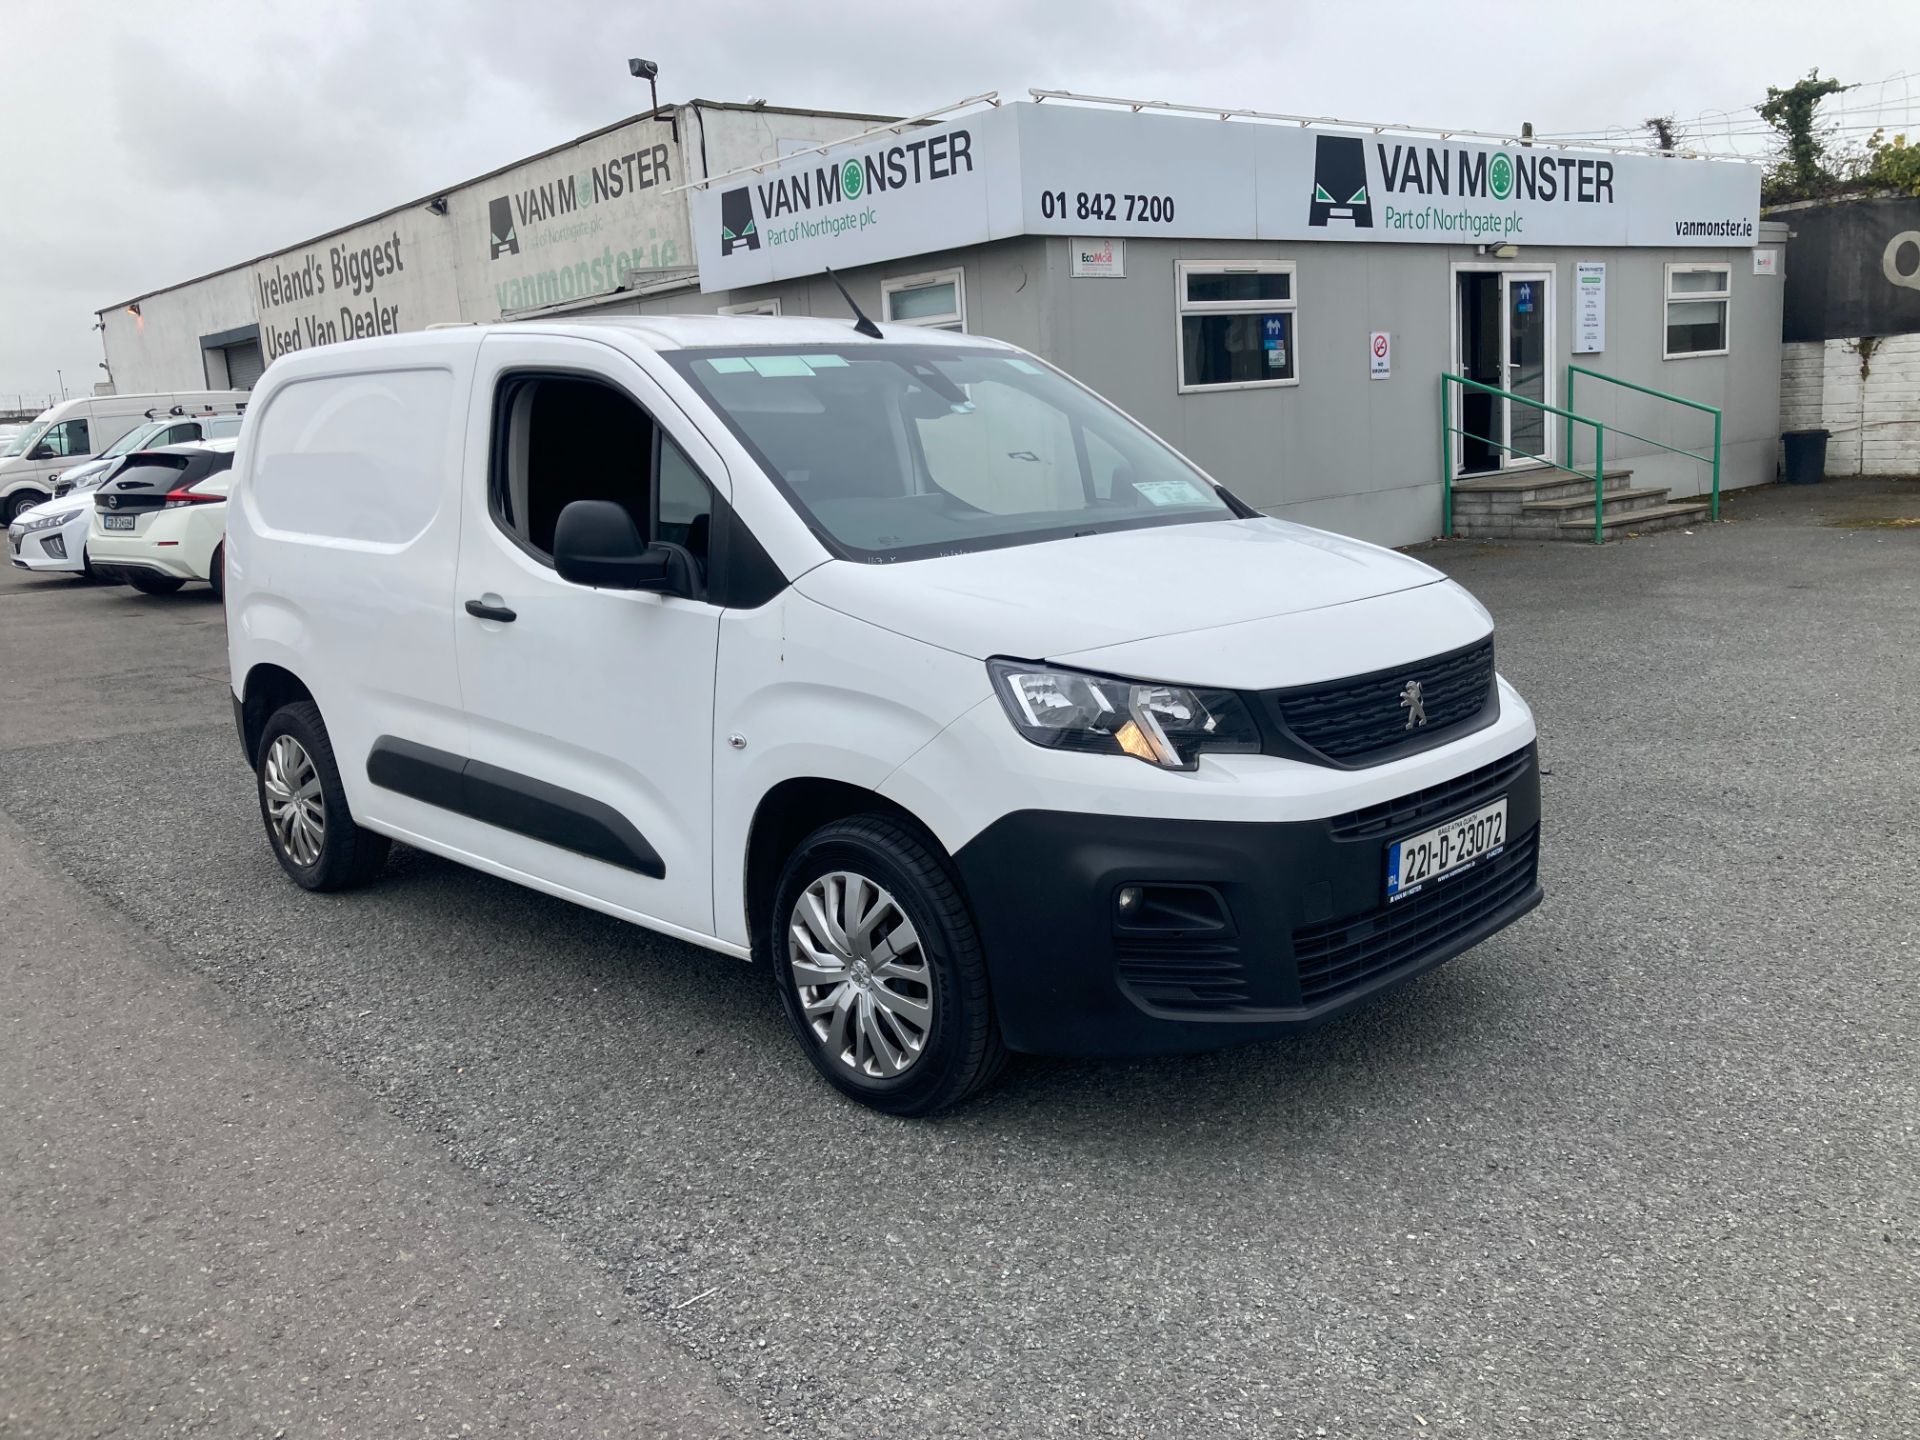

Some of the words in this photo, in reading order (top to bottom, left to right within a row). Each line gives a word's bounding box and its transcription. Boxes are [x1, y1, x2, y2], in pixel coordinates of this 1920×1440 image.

[515, 182, 556, 227] VAN
[557, 143, 671, 215] MONSTER
[757, 172, 810, 219] VAN
[815, 129, 974, 207] MONSTER
[1377, 143, 1449, 196] VAN
[1458, 150, 1614, 203] MONSTER
[767, 229, 788, 247] Part
[788, 222, 800, 242] of
[800, 212, 857, 239] Northgate
[859, 206, 877, 232] plc
[1041, 190, 1067, 219] 01
[1076, 192, 1117, 220] 842
[1124, 194, 1175, 223] 7200
[1385, 206, 1414, 230] Part
[1415, 206, 1432, 230] of
[1433, 208, 1502, 237] Northgate
[1504, 211, 1523, 237] plc
[1675, 217, 1752, 238] vanmonster.ie
[258, 254, 325, 309] Ireland's
[330, 231, 404, 296] Biggest
[495, 228, 679, 309] vanmonsterie
[265, 317, 302, 360] Used
[305, 314, 337, 347] Van
[340, 297, 398, 342] Dealer
[1404, 811, 1502, 885] 221-D-23072
